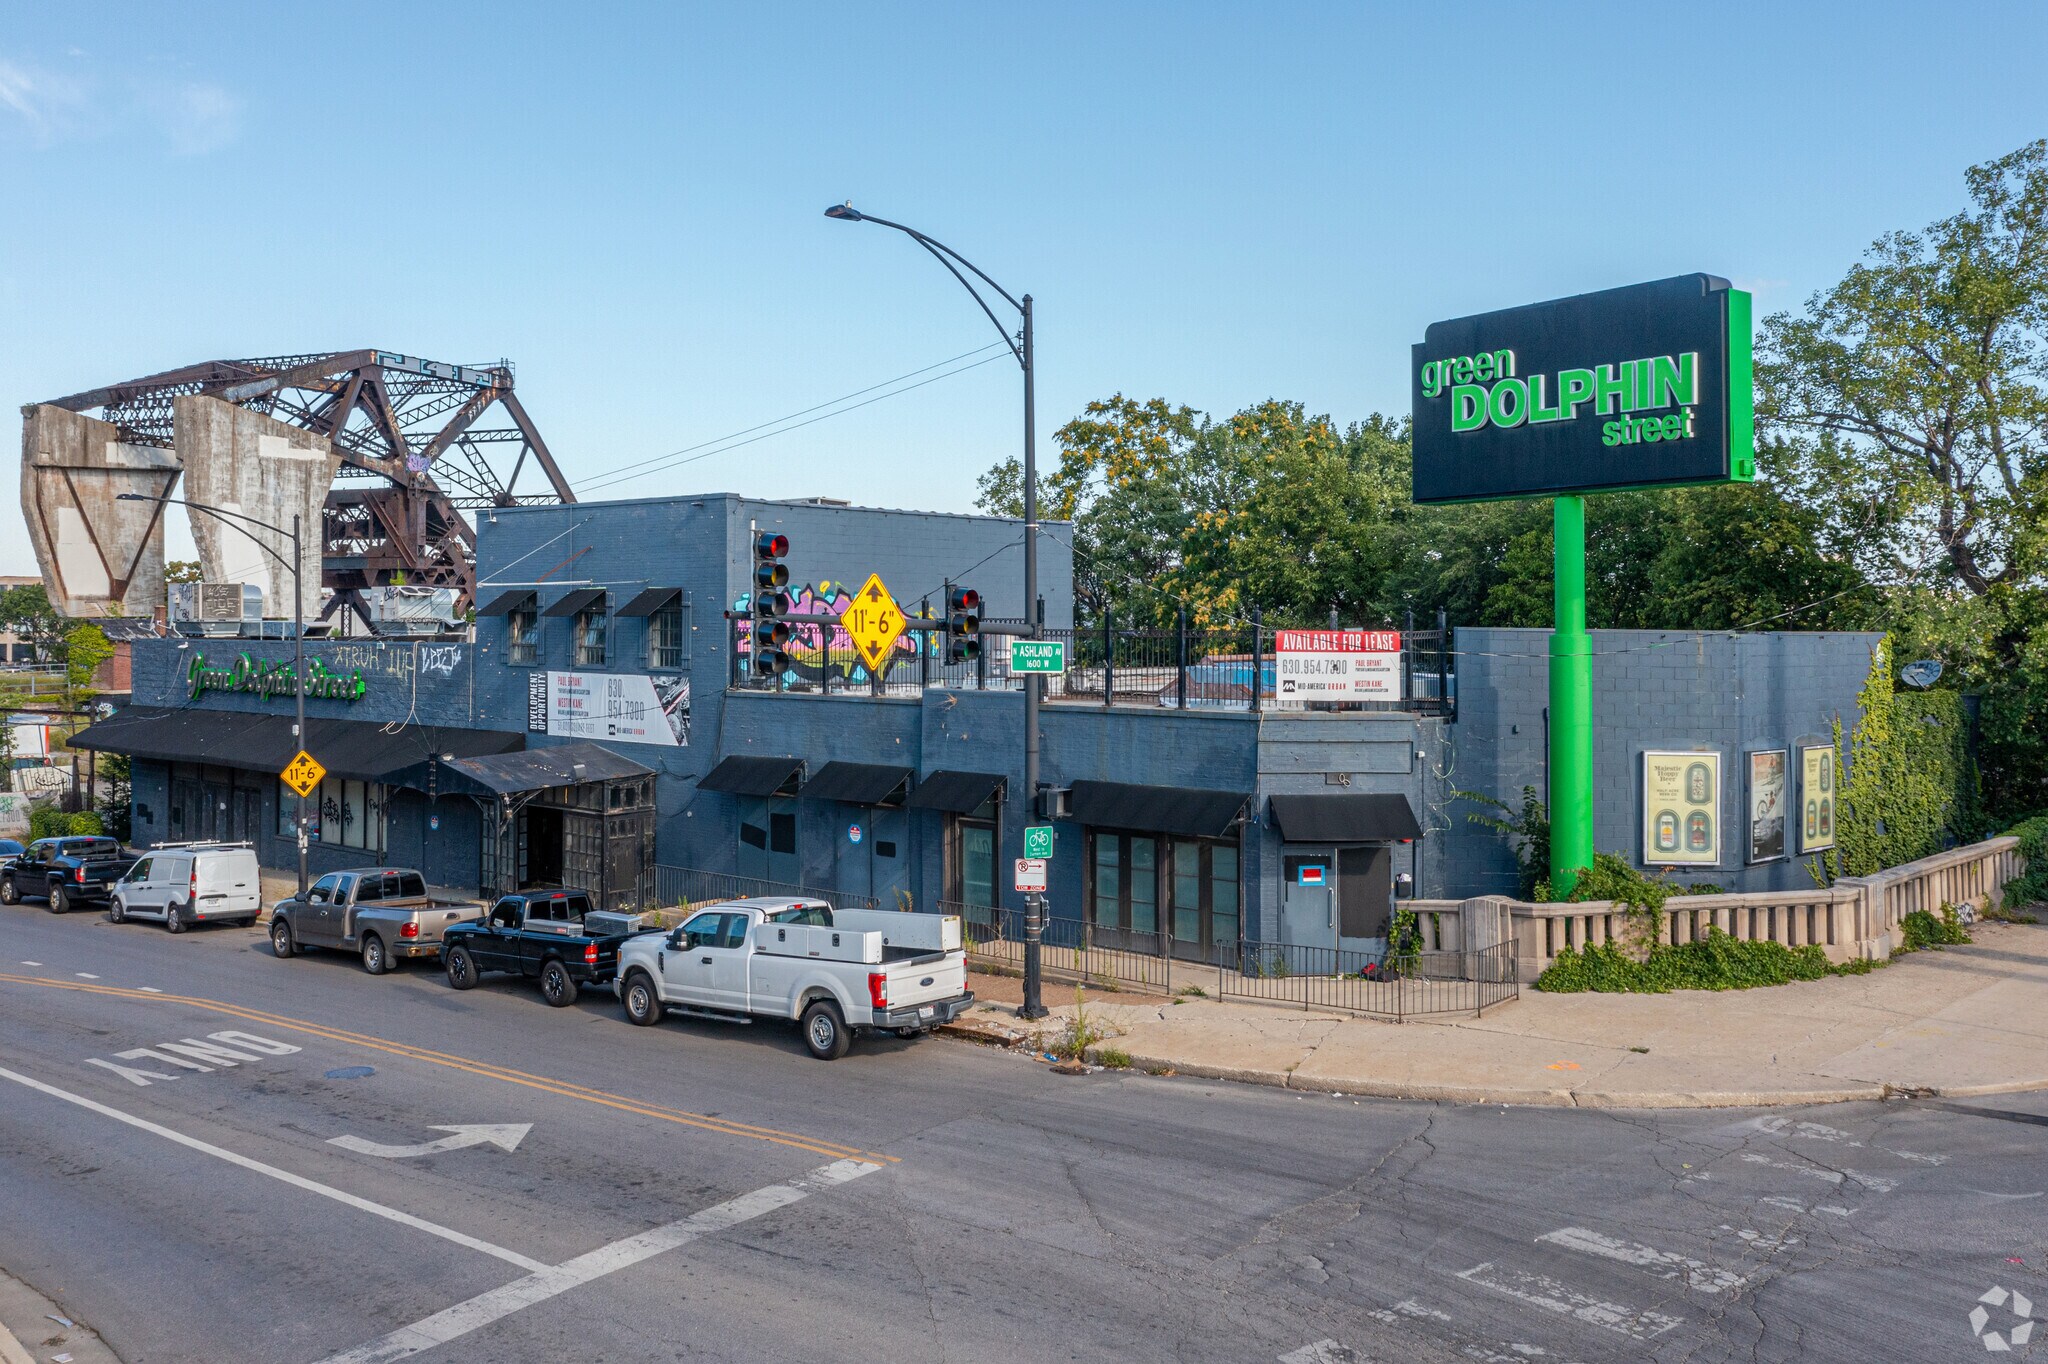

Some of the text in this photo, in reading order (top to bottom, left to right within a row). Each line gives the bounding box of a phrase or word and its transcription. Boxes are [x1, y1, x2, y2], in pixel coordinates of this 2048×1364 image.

[1421, 349, 1515, 398] green
[1451, 351, 1698, 432] DOLPHIN
[1602, 406, 1695, 446] street
[1020, 646, 1053, 657] ASHLAND
[1026, 660, 1049, 668] 1600 W
[1283, 633, 1394, 651] AVAILABLE FOR LEASE
[530, 673, 538, 730] DEVELOPMENT
[538, 673, 546, 730] OPPORTUNITY
[83, 1030, 303, 1087] ONLY
